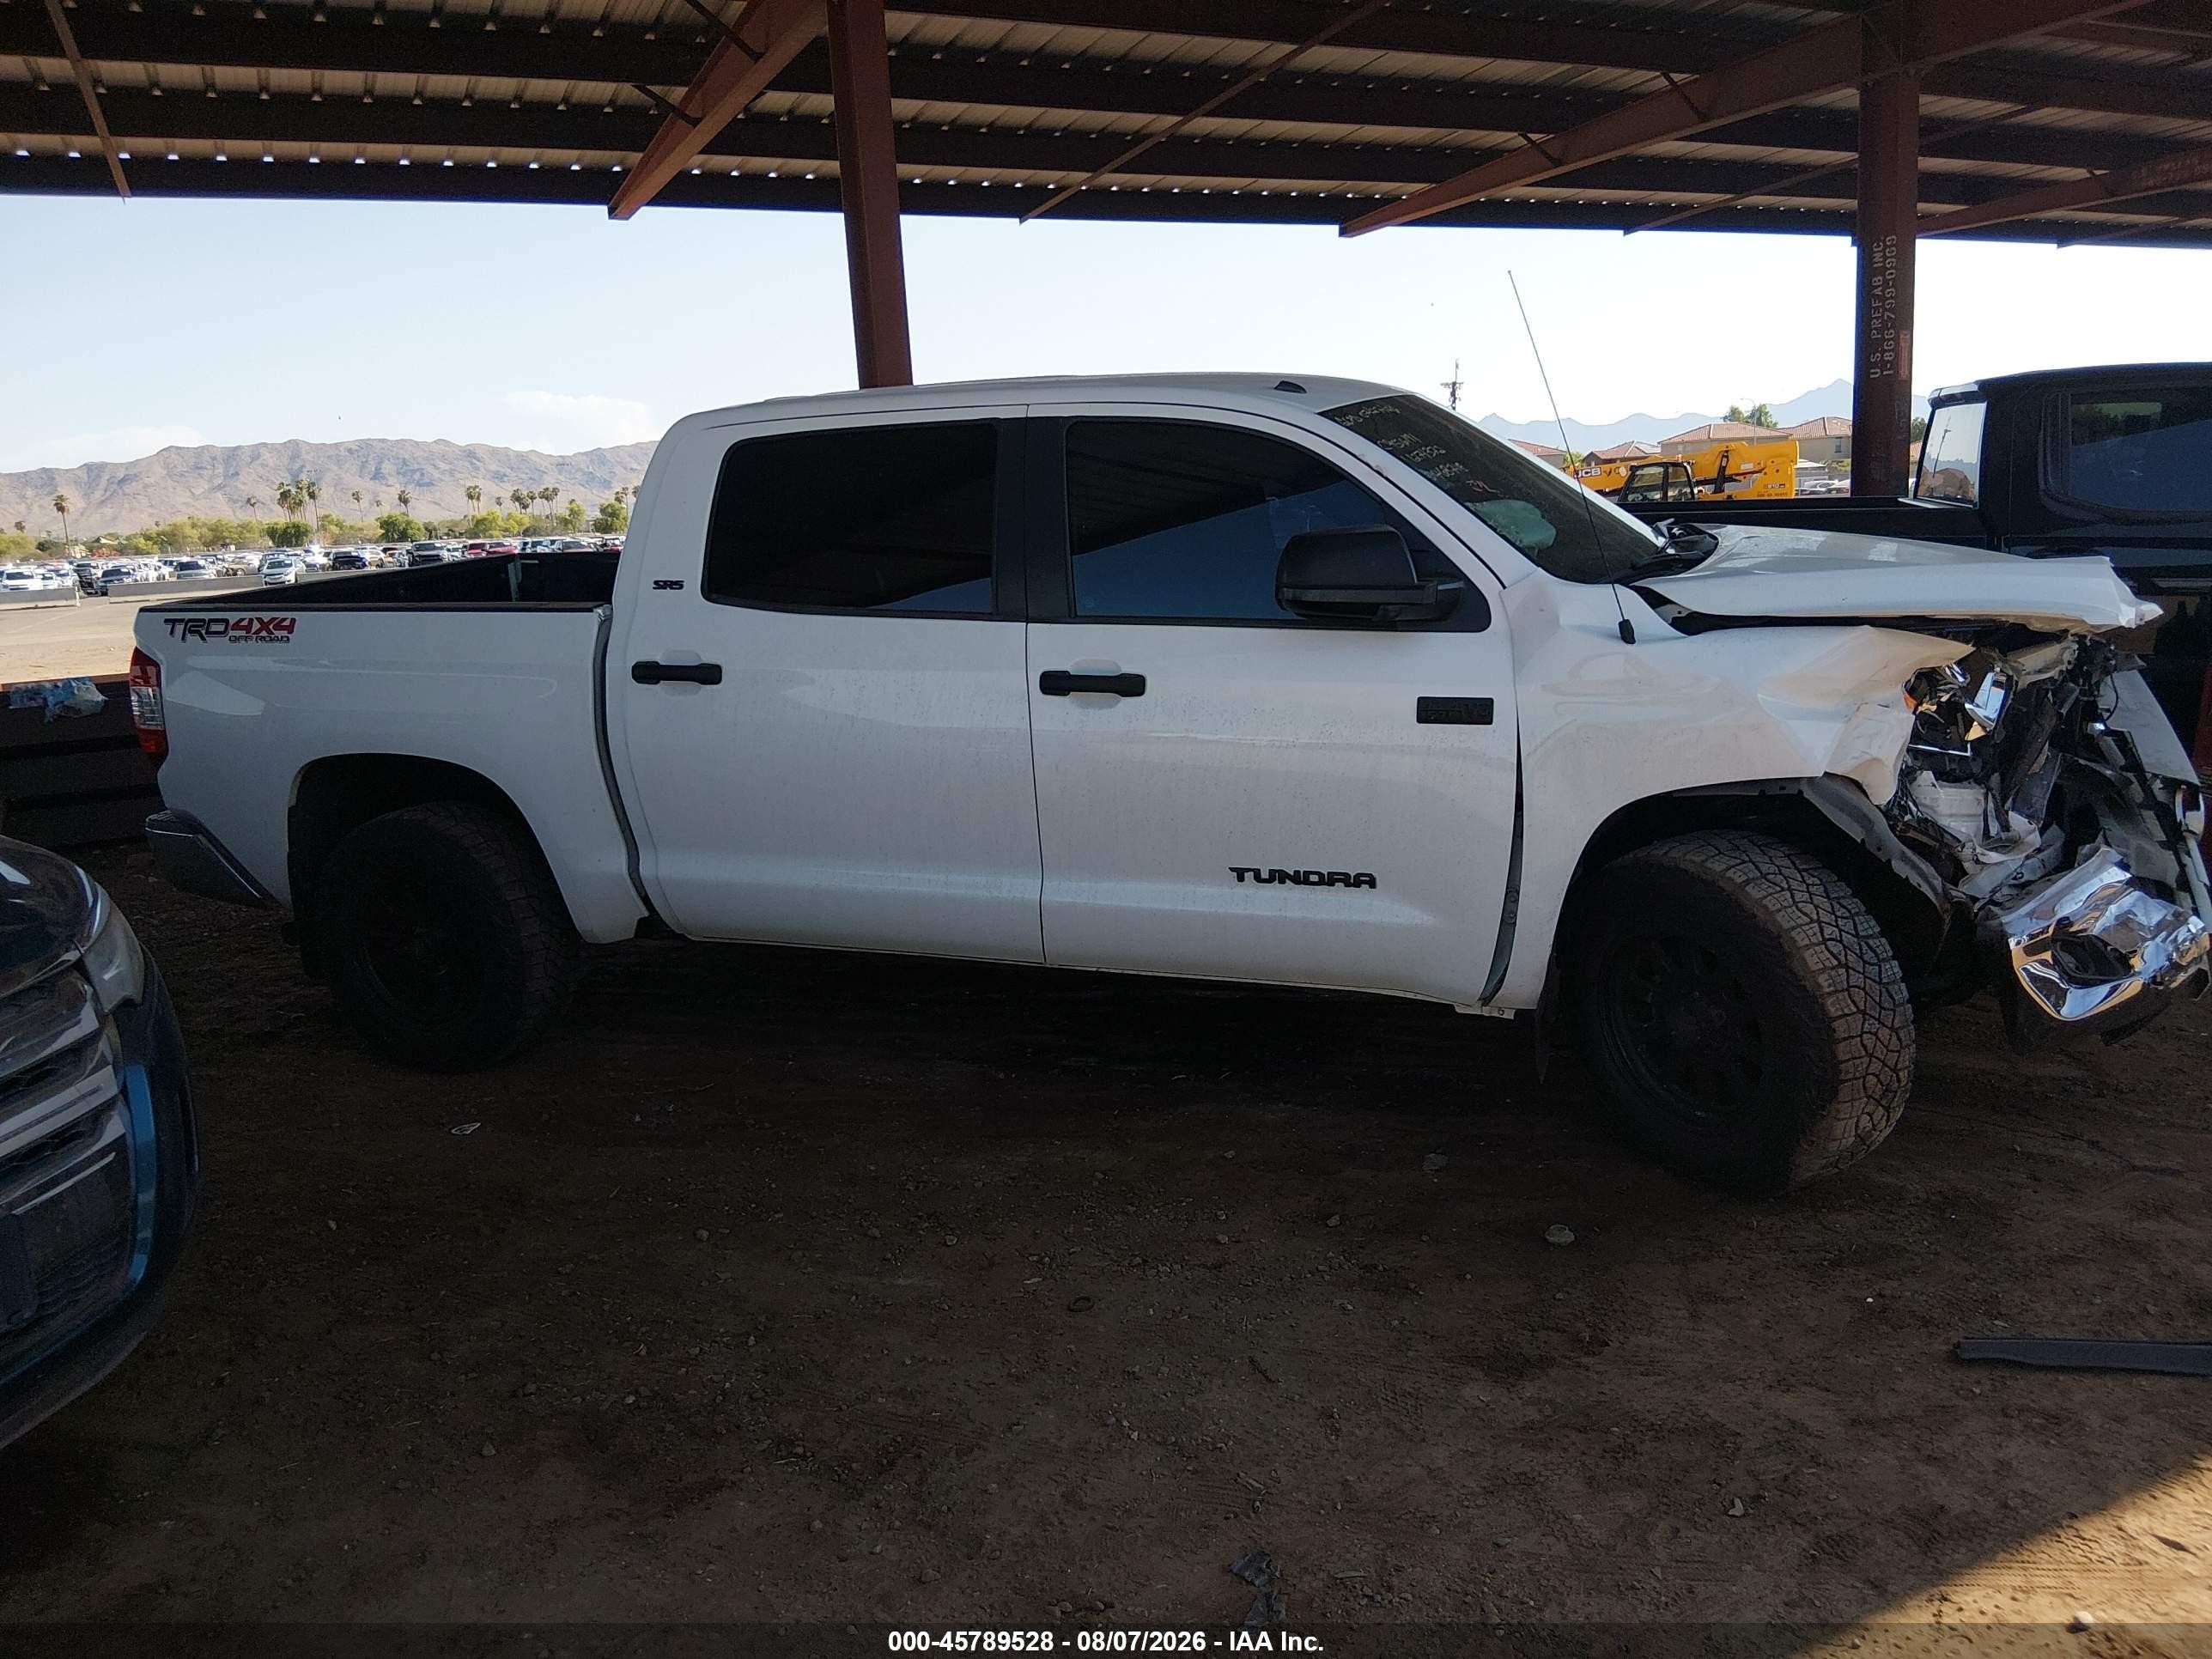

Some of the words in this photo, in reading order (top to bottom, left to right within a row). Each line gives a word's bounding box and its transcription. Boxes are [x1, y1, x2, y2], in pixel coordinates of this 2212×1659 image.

[1872, 236, 1885, 268] INC.
[1870, 276, 1883, 338] PREFAB
[1869, 347, 1882, 379] U.S.
[1574, 467, 1602, 478] JCB
[163, 617, 229, 643] TRD
[1228, 866, 1377, 890] TUNDRA
